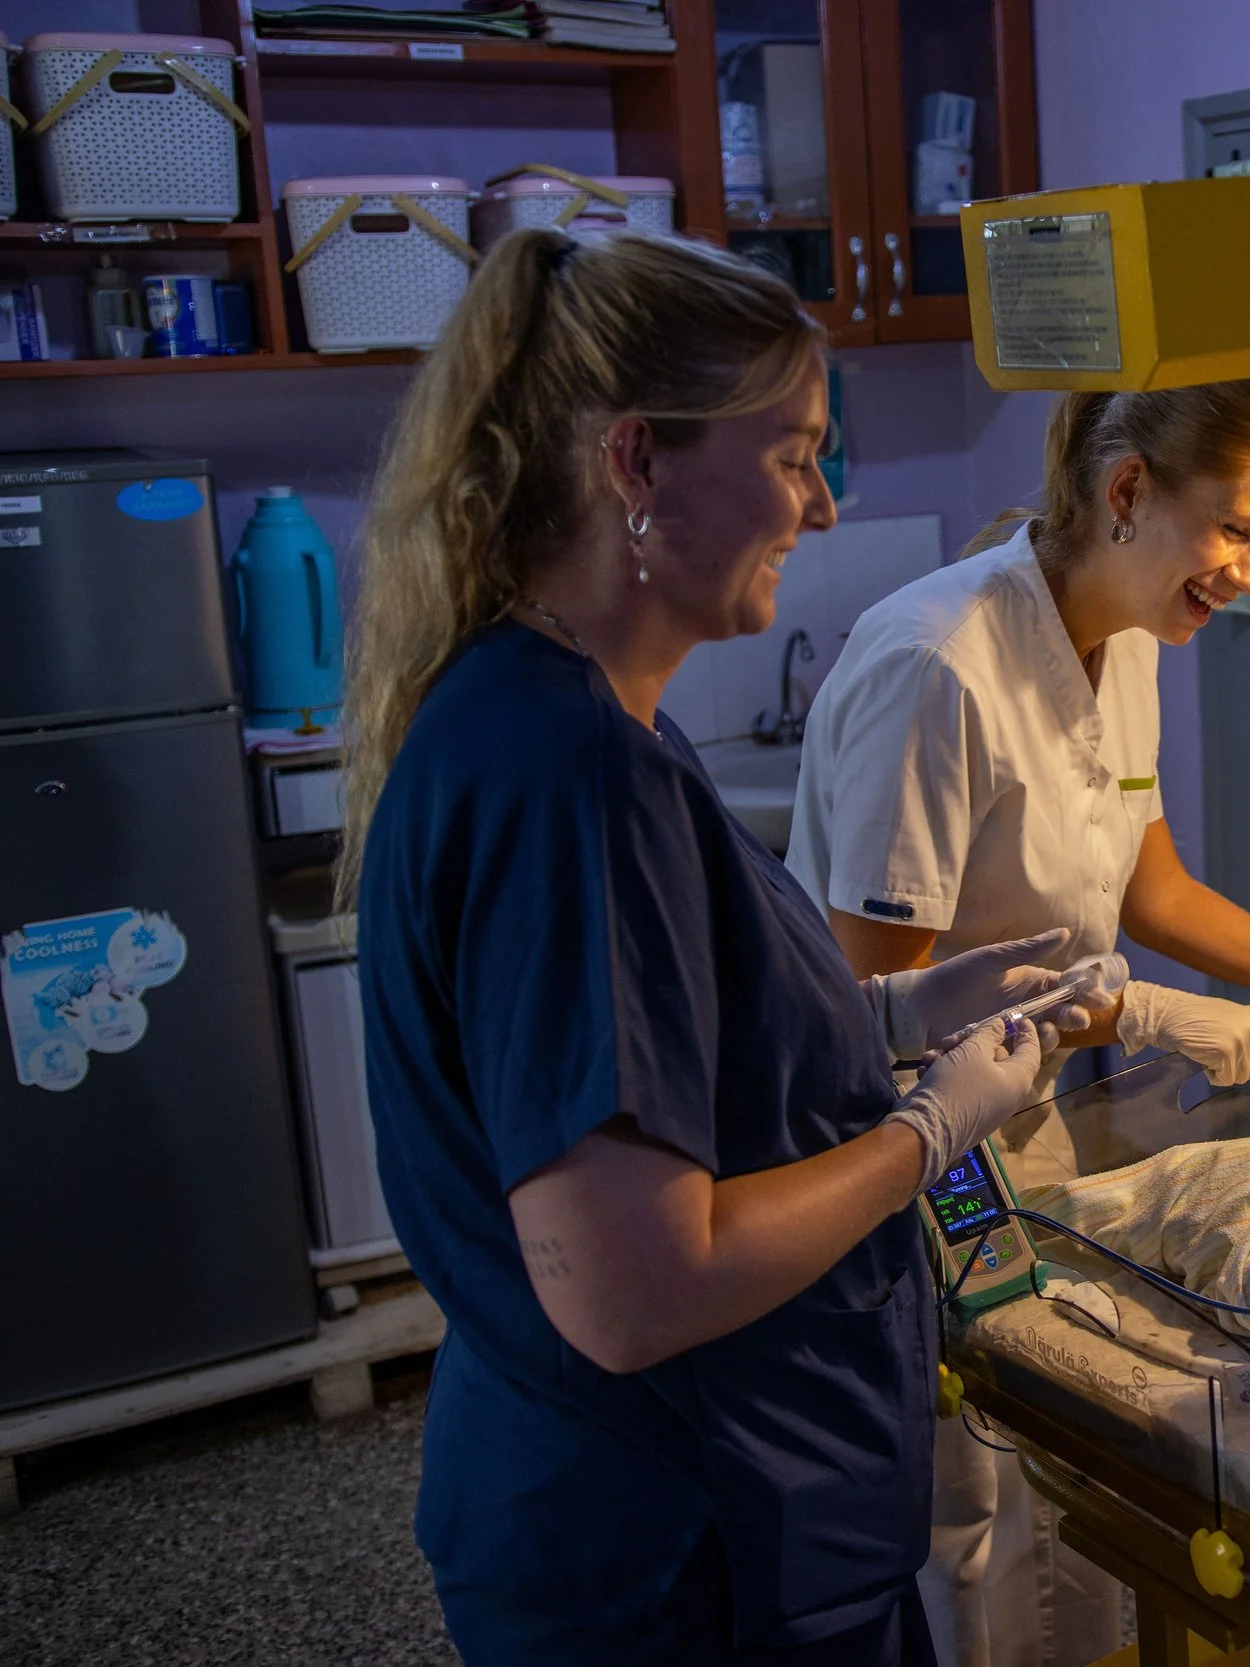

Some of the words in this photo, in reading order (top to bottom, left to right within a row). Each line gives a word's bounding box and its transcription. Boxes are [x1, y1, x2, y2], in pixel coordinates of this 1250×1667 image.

[56, 926, 97, 942] HOME
[14, 938, 99, 962] COOLNESS
[948, 1167, 965, 1182] 97
